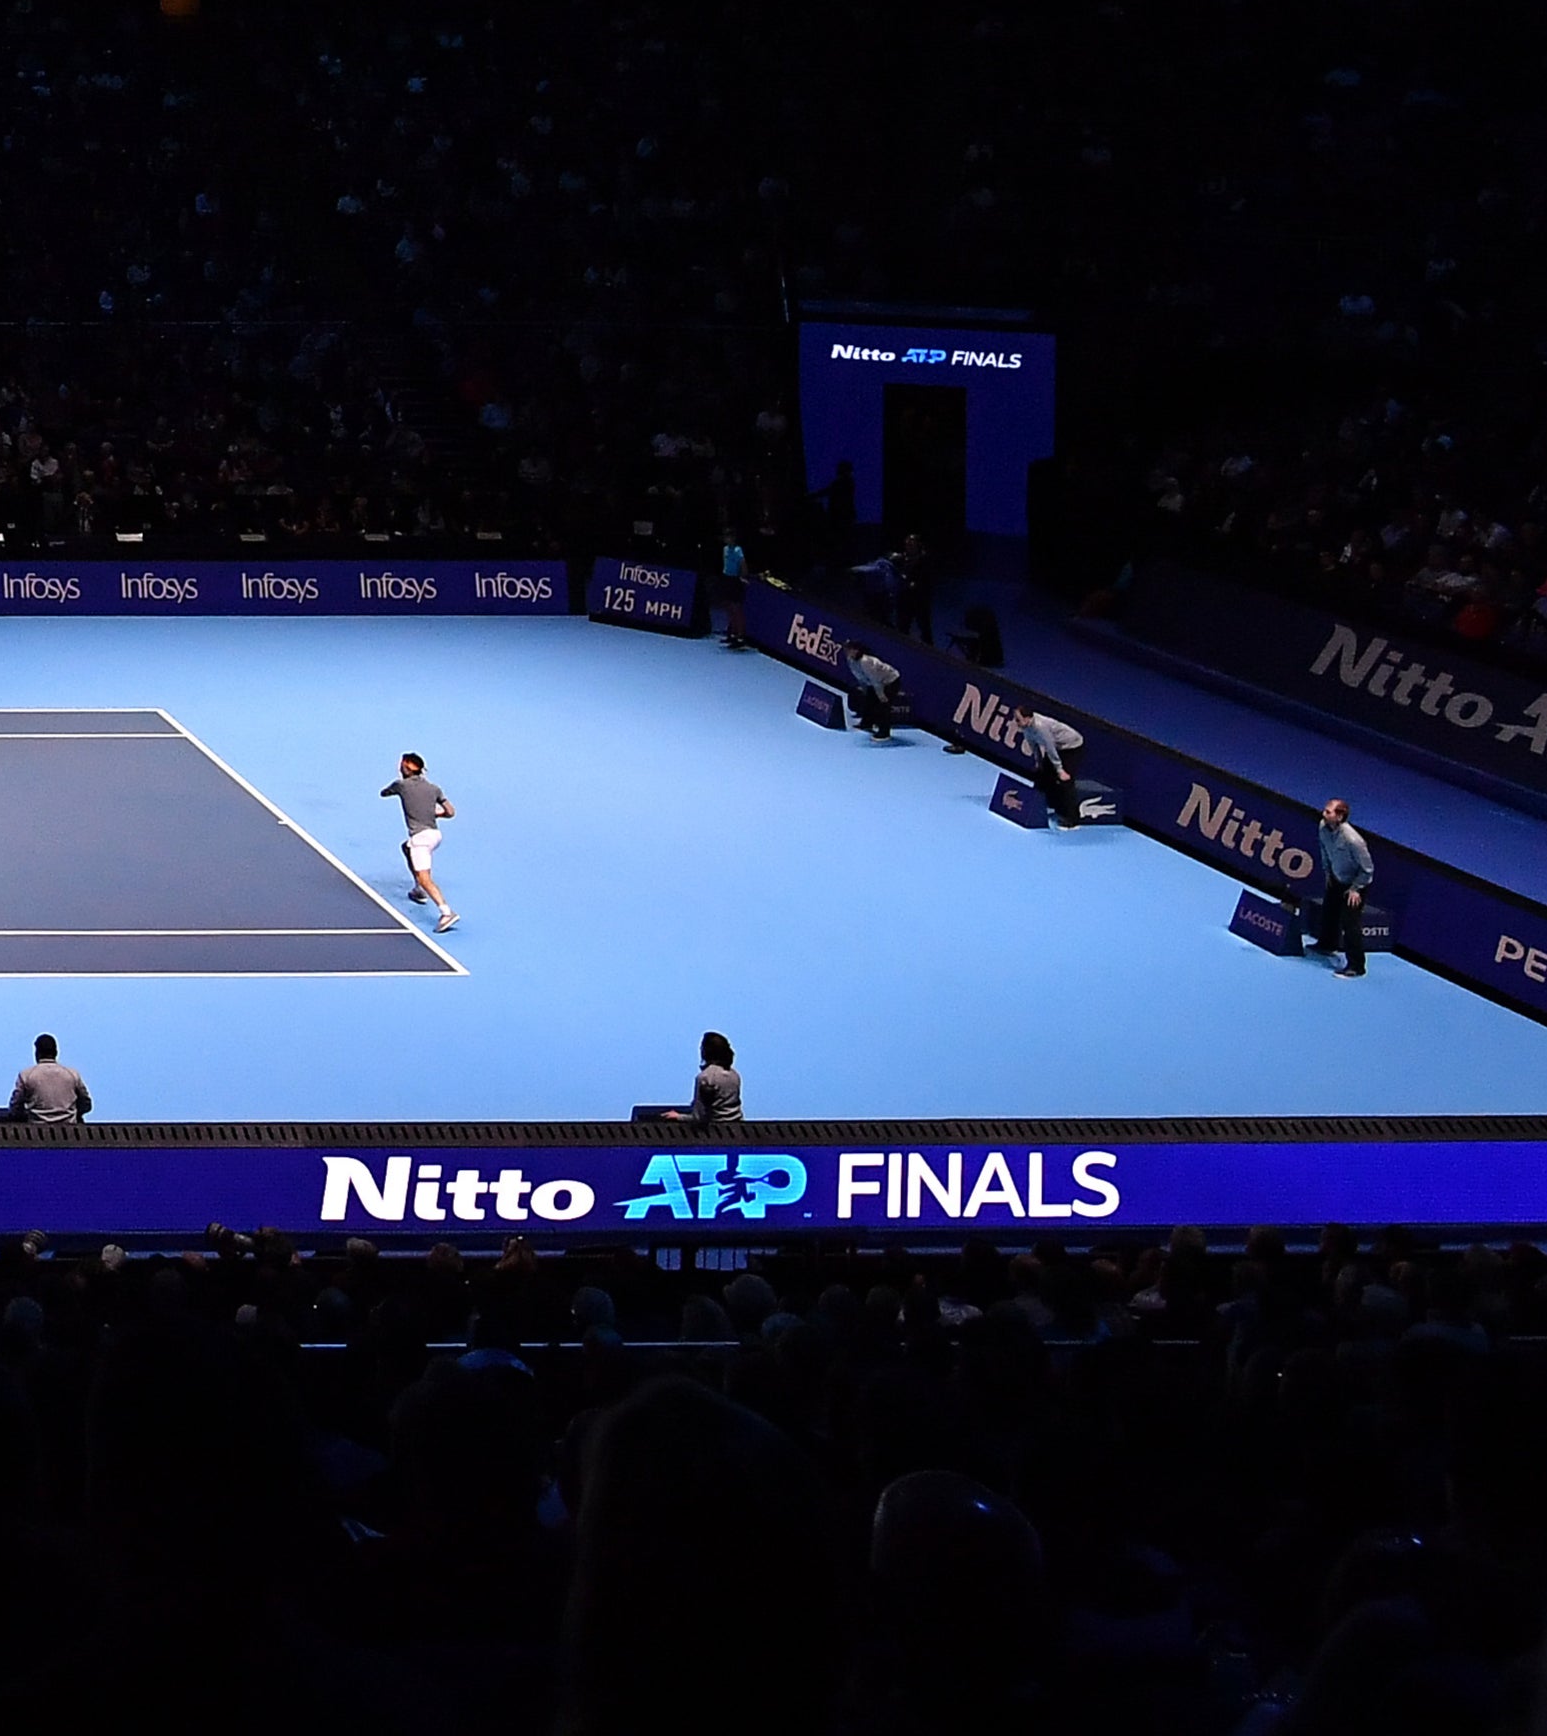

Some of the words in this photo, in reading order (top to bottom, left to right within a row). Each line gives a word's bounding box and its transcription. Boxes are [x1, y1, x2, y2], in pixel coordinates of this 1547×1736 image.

[830, 344, 896, 362] Nitto
[901, 347, 947, 364] ATP
[951, 350, 1023, 369] FINALS
[3, 572, 81, 603] Infosys
[121, 572, 198, 604] Infosys
[241, 572, 319, 604] Infosys
[360, 572, 437, 603] Infosys
[475, 572, 552, 603] Infosys
[619, 562, 670, 589] Infosys
[604, 585, 636, 612] 125
[645, 600, 682, 620] MPH
[787, 614, 842, 665] FedEx
[1309, 624, 1494, 728] Nitto
[953, 683, 1047, 758] Nit
[1176, 782, 1314, 880] Nitto
[1239, 906, 1284, 937] LACOSTE
[320, 1156, 596, 1221] Nitto
[613, 1154, 808, 1219] ATP
[837, 1151, 1120, 1219] FINALS
